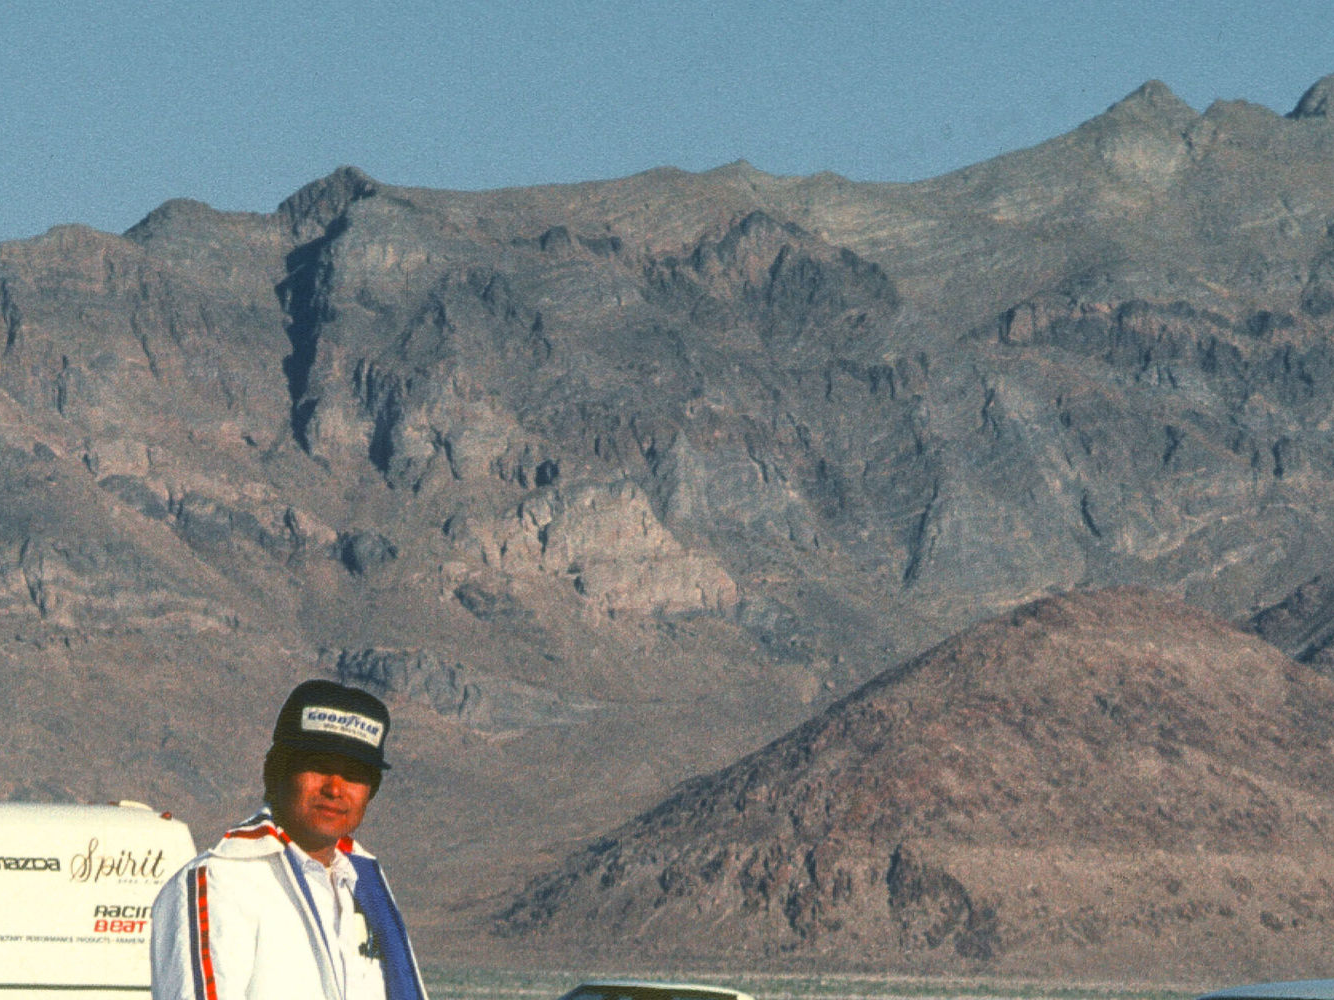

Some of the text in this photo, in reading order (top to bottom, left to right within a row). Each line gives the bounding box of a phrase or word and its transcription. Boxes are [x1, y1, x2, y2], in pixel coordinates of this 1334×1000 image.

[308, 711, 379, 736] GOODYEAR
[70, 837, 165, 883] Spirit
[94, 904, 153, 919] RaCIN
